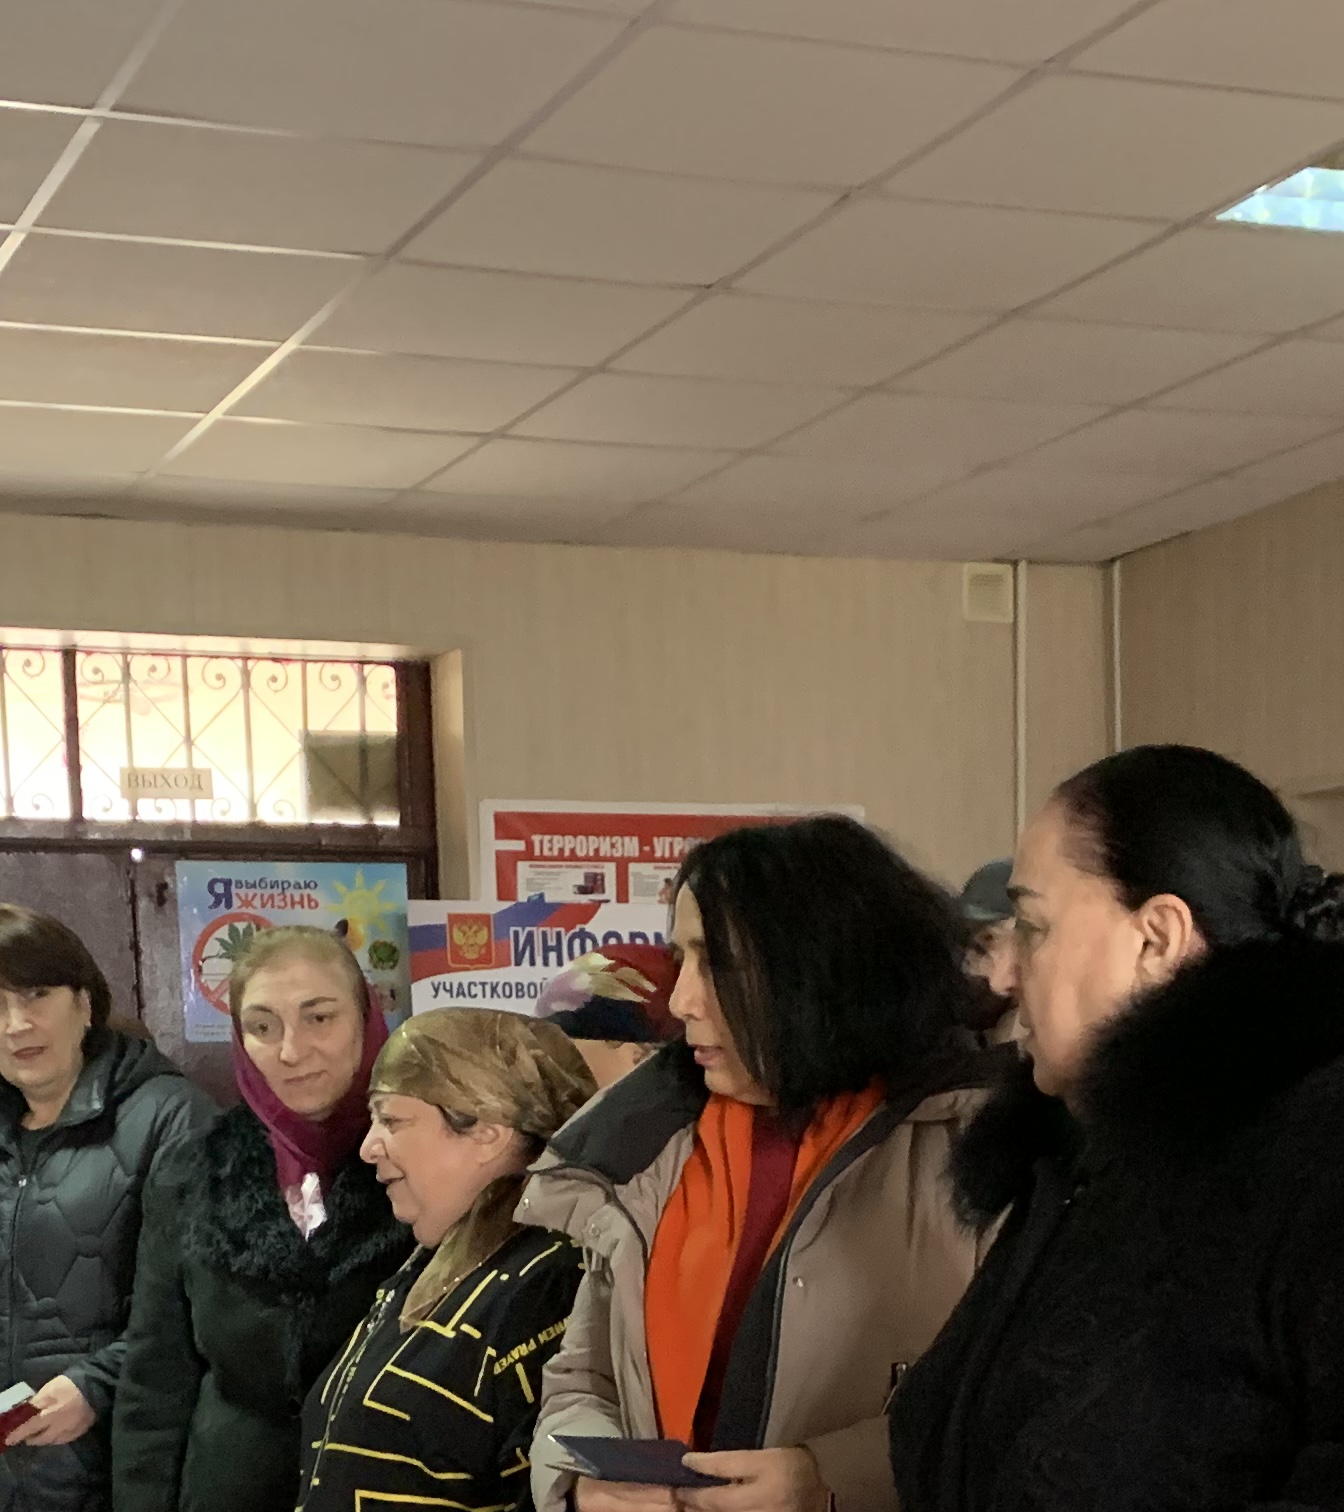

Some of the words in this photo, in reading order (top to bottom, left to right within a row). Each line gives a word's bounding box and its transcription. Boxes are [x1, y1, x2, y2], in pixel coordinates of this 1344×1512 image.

[127, 773, 204, 791] ВЫХОД
[531, 834, 640, 858] ТЕРРОРИЗМ
[207, 878, 233, 910] Я
[234, 877, 318, 893] выбираю
[512, 927, 666, 968] ИНФ
